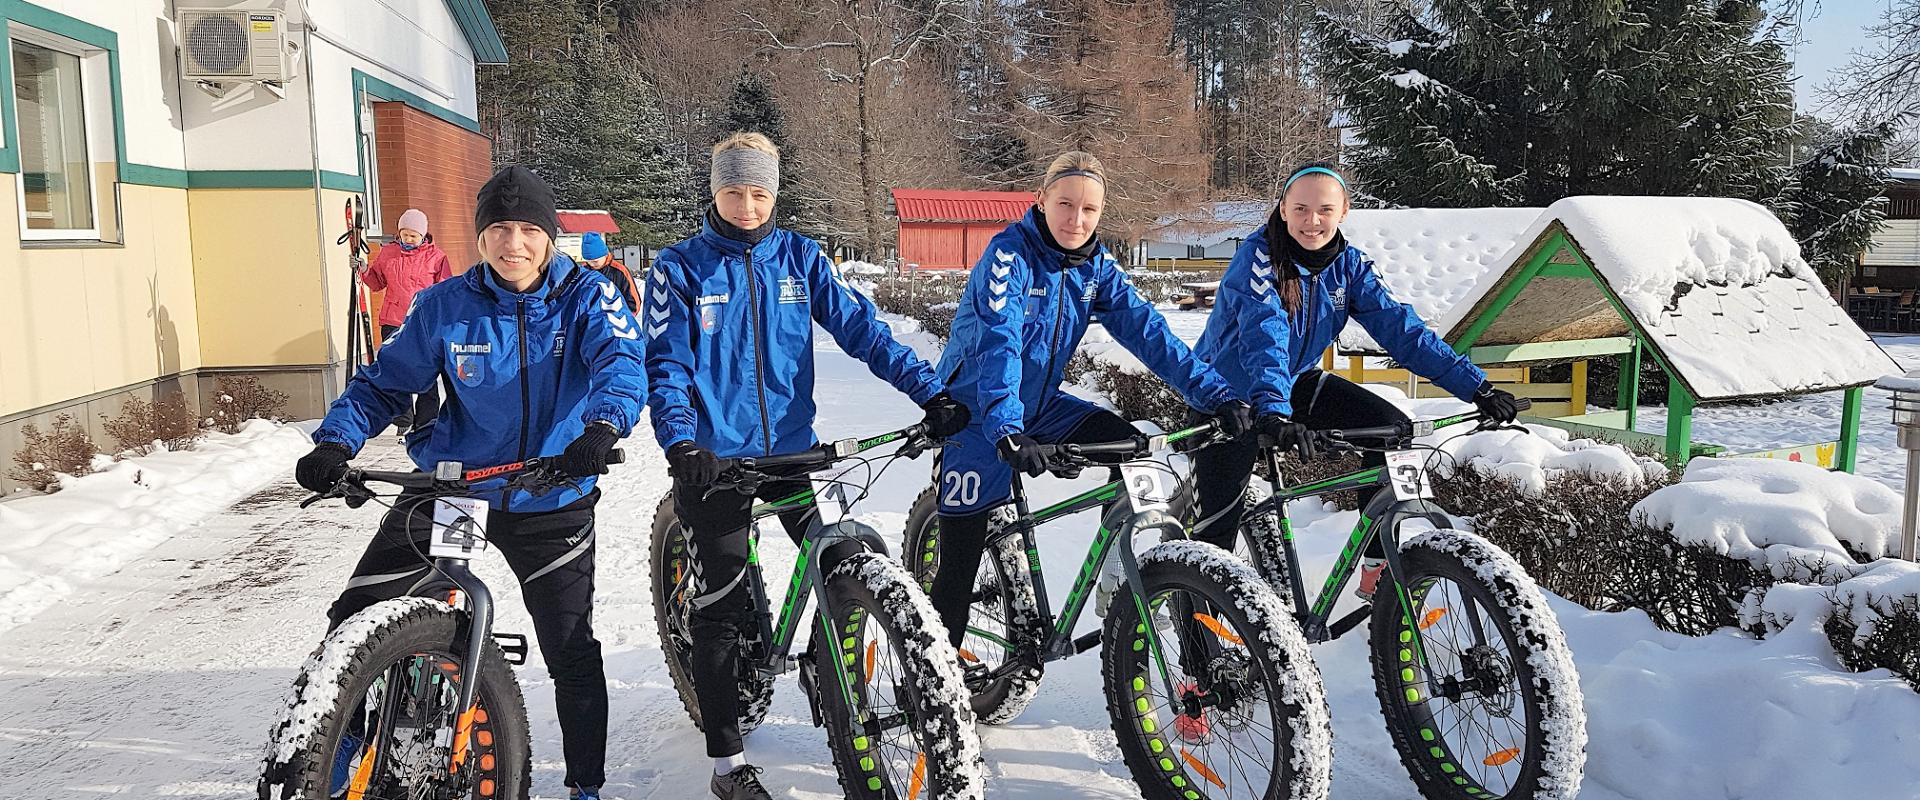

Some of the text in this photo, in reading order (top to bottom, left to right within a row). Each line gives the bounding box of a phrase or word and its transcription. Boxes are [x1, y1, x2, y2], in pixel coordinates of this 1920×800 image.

[695, 293, 729, 306] hummel
[450, 342, 492, 353] hummel
[944, 470, 981, 507] 20
[1133, 474, 1155, 507] 2
[1397, 464, 1423, 495] 3
[824, 482, 850, 515] 1
[442, 515, 476, 553] 4
